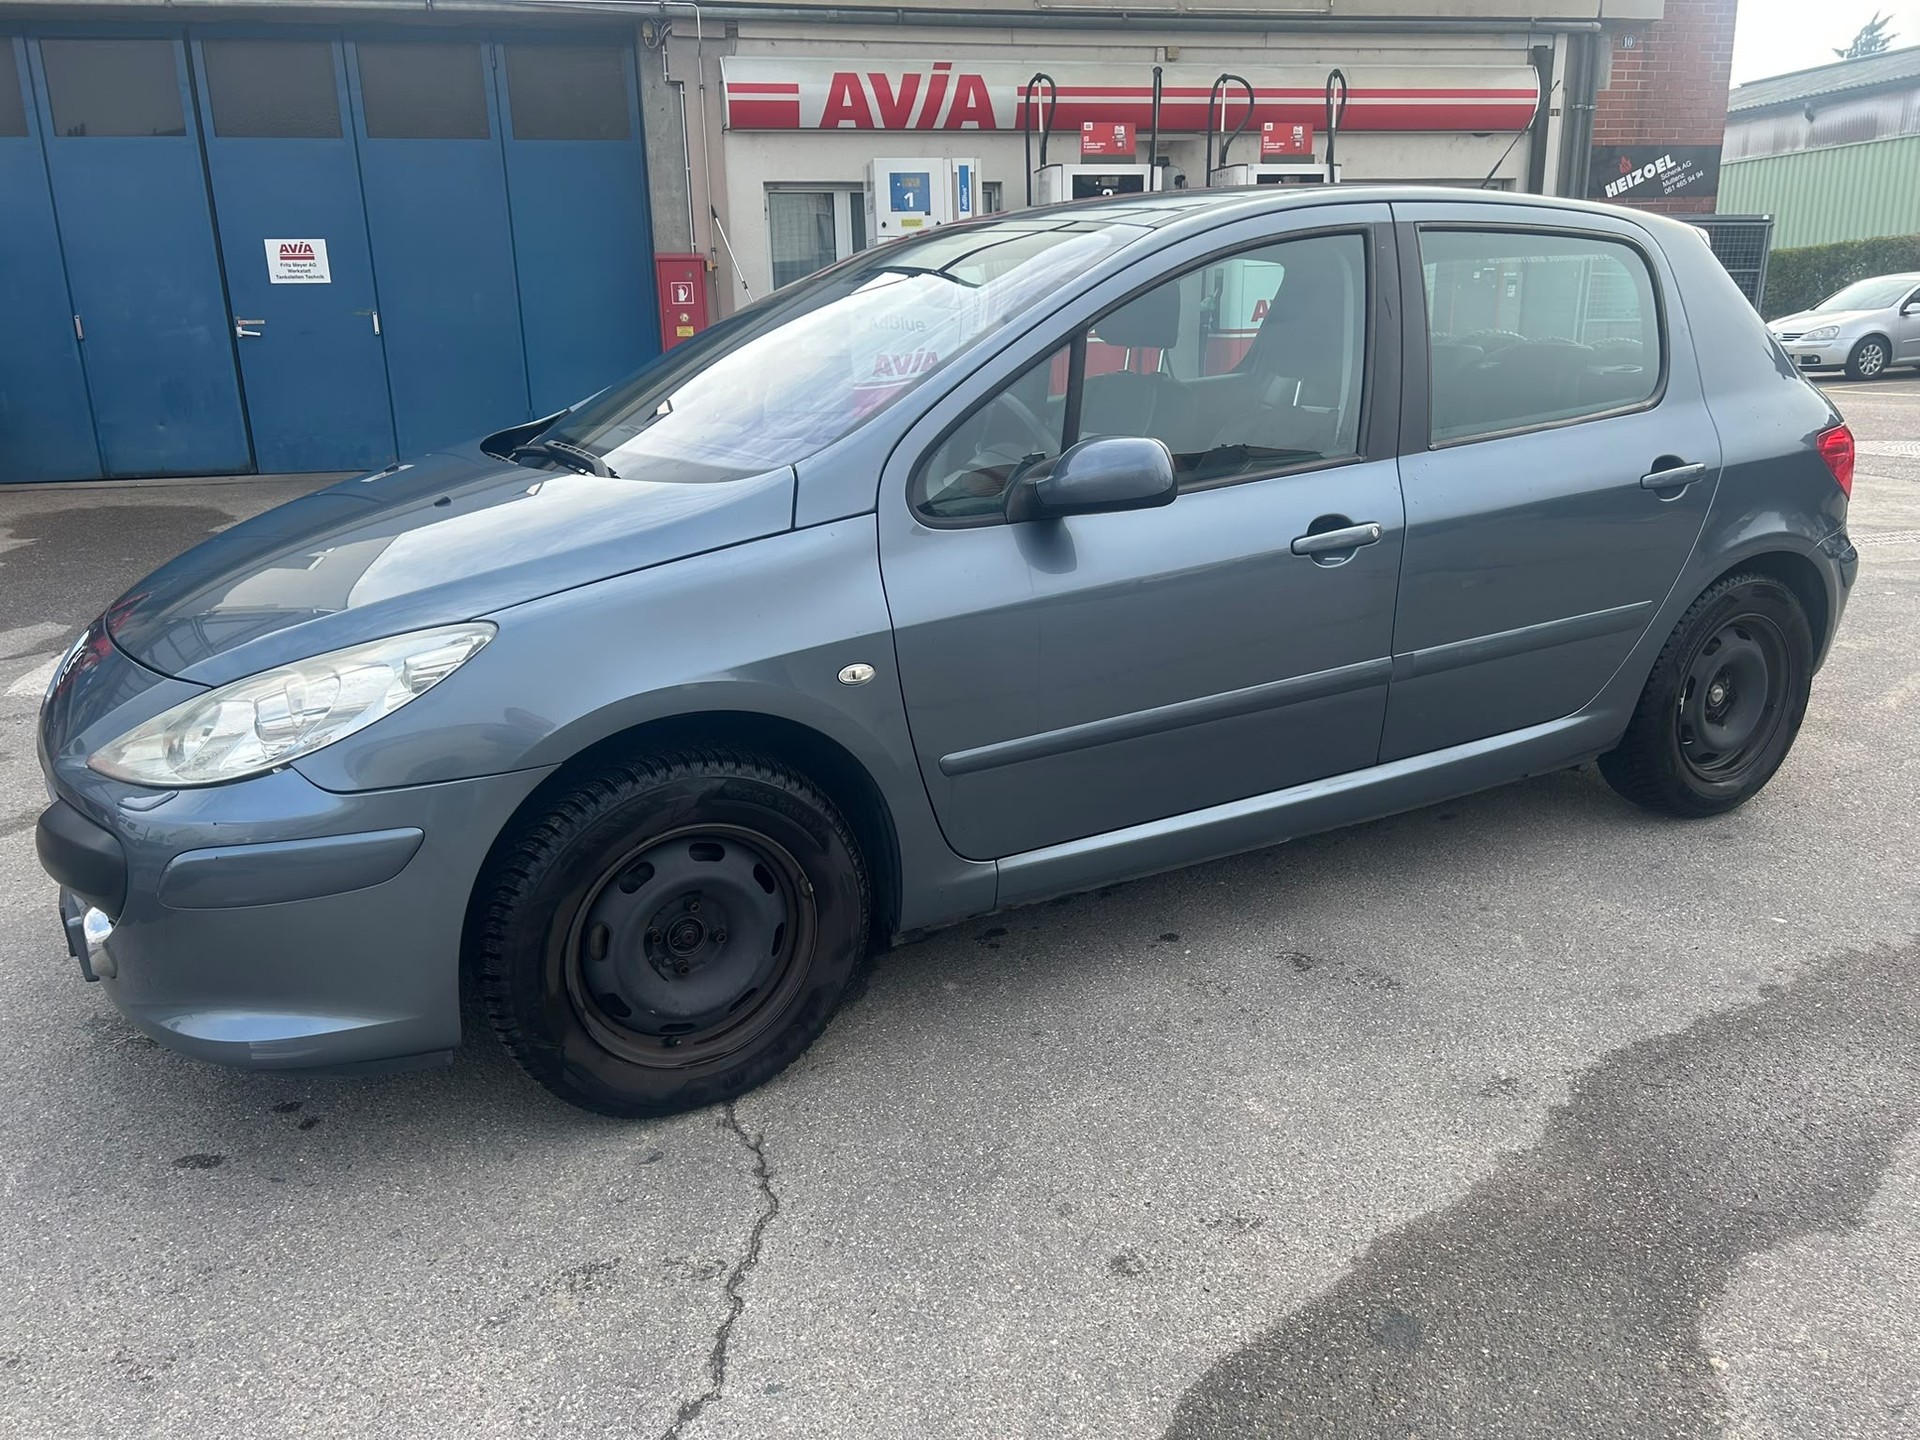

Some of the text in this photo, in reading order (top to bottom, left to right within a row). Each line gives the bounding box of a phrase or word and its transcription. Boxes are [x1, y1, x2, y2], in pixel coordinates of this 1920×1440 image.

[1624, 36, 1633, 47] 10
[819, 62, 997, 129] AVIA
[1605, 154, 1676, 198] HEIZOEL
[1660, 166, 1682, 180] Schenk
[1662, 172, 1685, 187] Muttenz
[1664, 170, 1704, 195] 061 465 94 94
[904, 192, 914, 207] 1
[279, 241, 314, 253] AVIA
